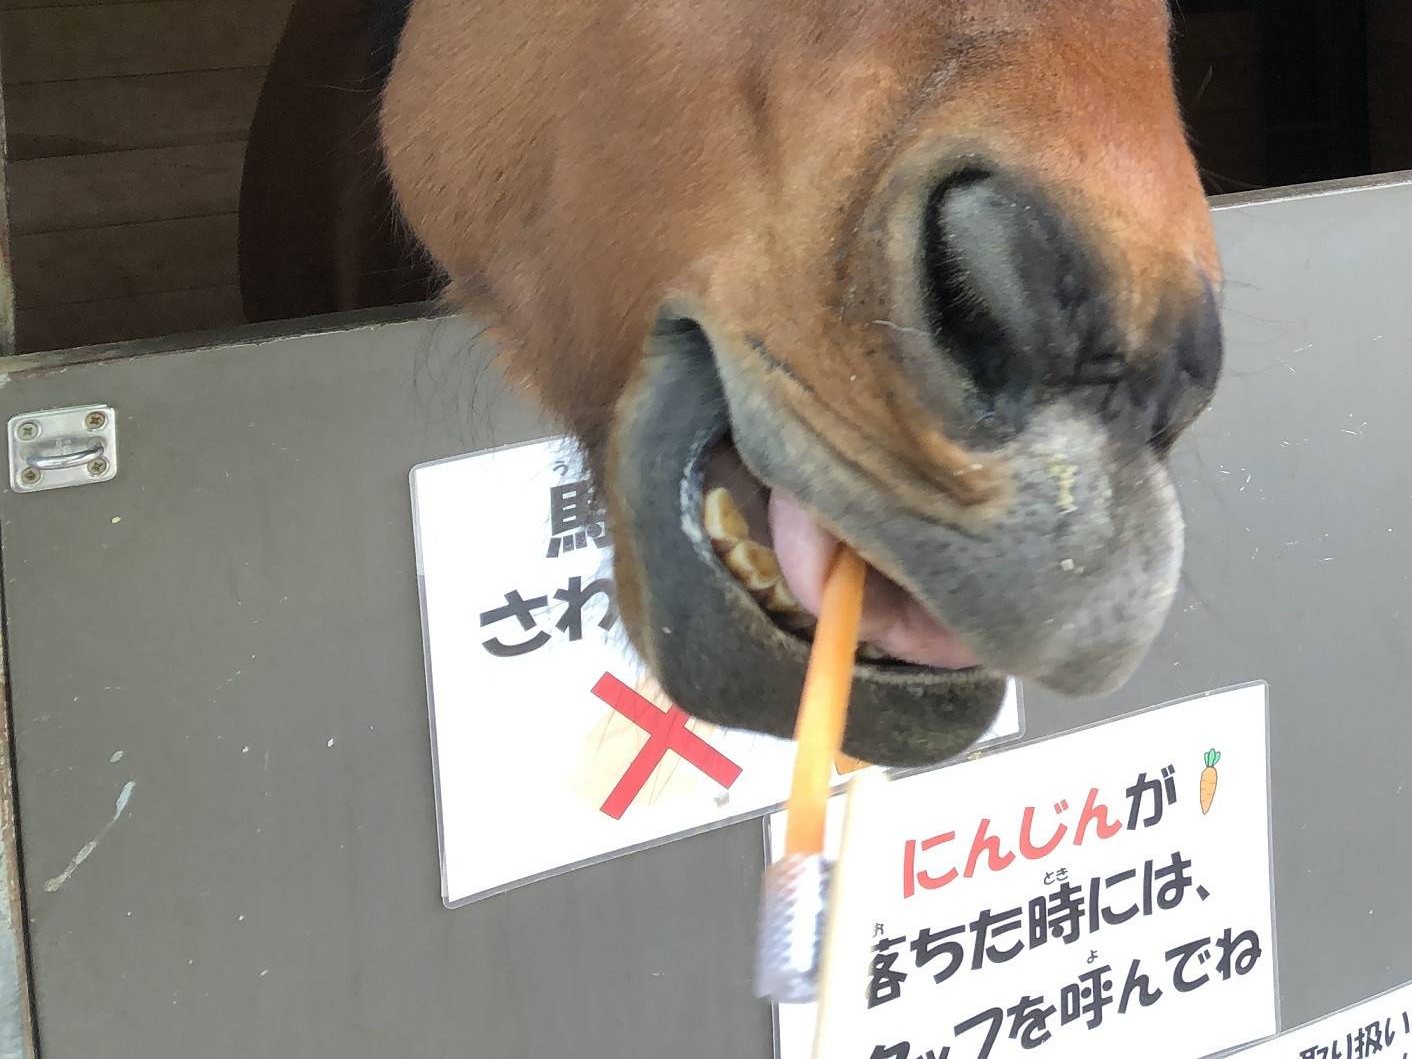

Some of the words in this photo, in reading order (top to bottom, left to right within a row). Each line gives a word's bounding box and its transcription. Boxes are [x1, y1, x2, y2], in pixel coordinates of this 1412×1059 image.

[480, 576, 617, 658] さわ
[904, 765, 1178, 899] にんじんが
[1043, 867, 1069, 886] とき
[1086, 949, 1099, 964] よ
